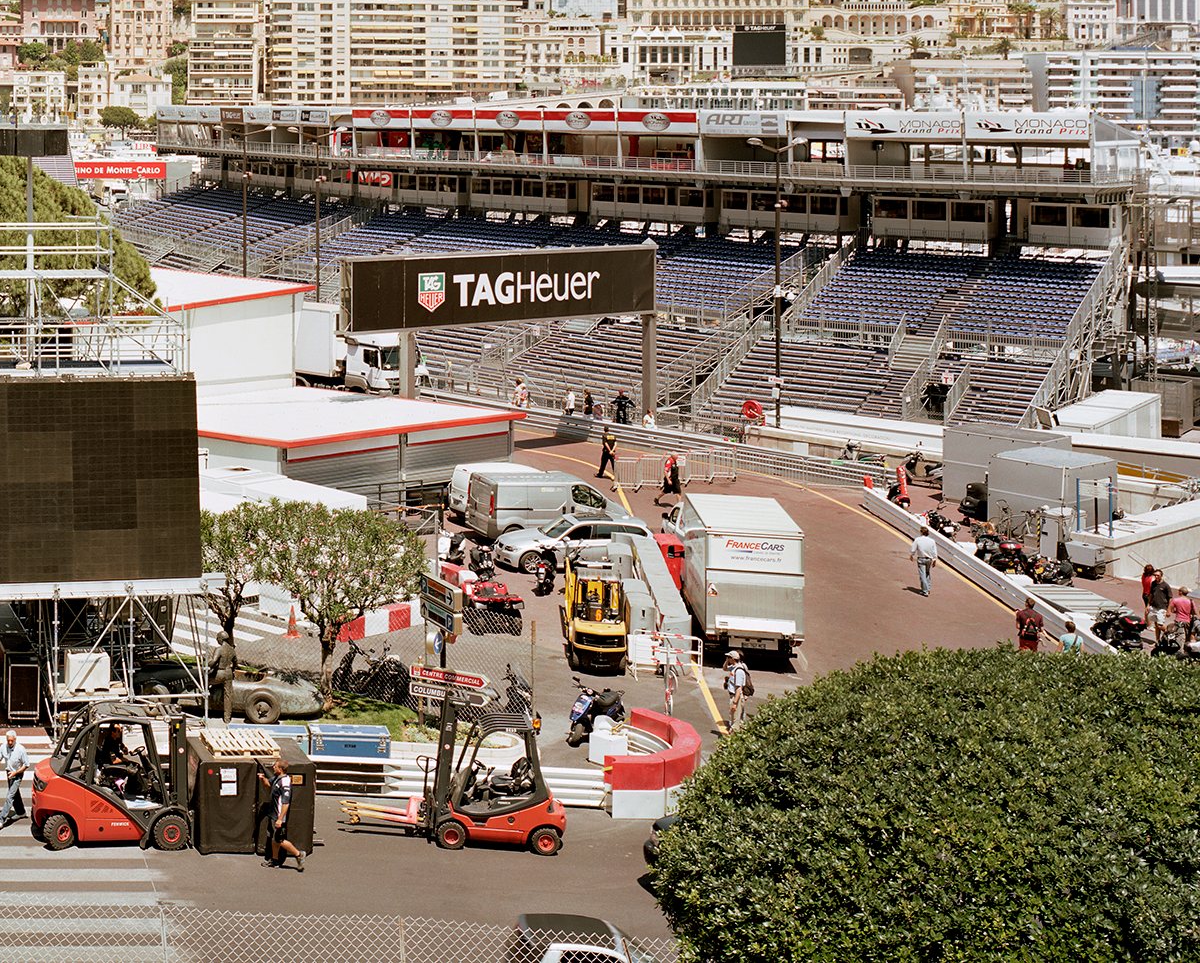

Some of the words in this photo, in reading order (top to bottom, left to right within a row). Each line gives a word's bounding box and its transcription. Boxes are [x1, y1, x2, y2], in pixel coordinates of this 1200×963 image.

[706, 113, 750, 126] ART
[899, 119, 961, 128] MONACO
[1014, 118, 1087, 128] MONACO
[937, 127, 961, 135] Prix
[1014, 127, 1053, 135] Grand
[1058, 127, 1087, 135] Prix
[106, 165, 160, 174] MONTE-CARLO
[422, 275, 442, 291] TAG
[453, 270, 600, 307] TAGHeuer
[419, 291, 445, 312] HEUER
[730, 555, 782, 563] www.francecars.fr
[595, 609, 603, 621] 6
[422, 669, 443, 679] CENTRE
[443, 673, 481, 685] COMMERCIAL
[413, 686, 446, 698] COLUMBU
